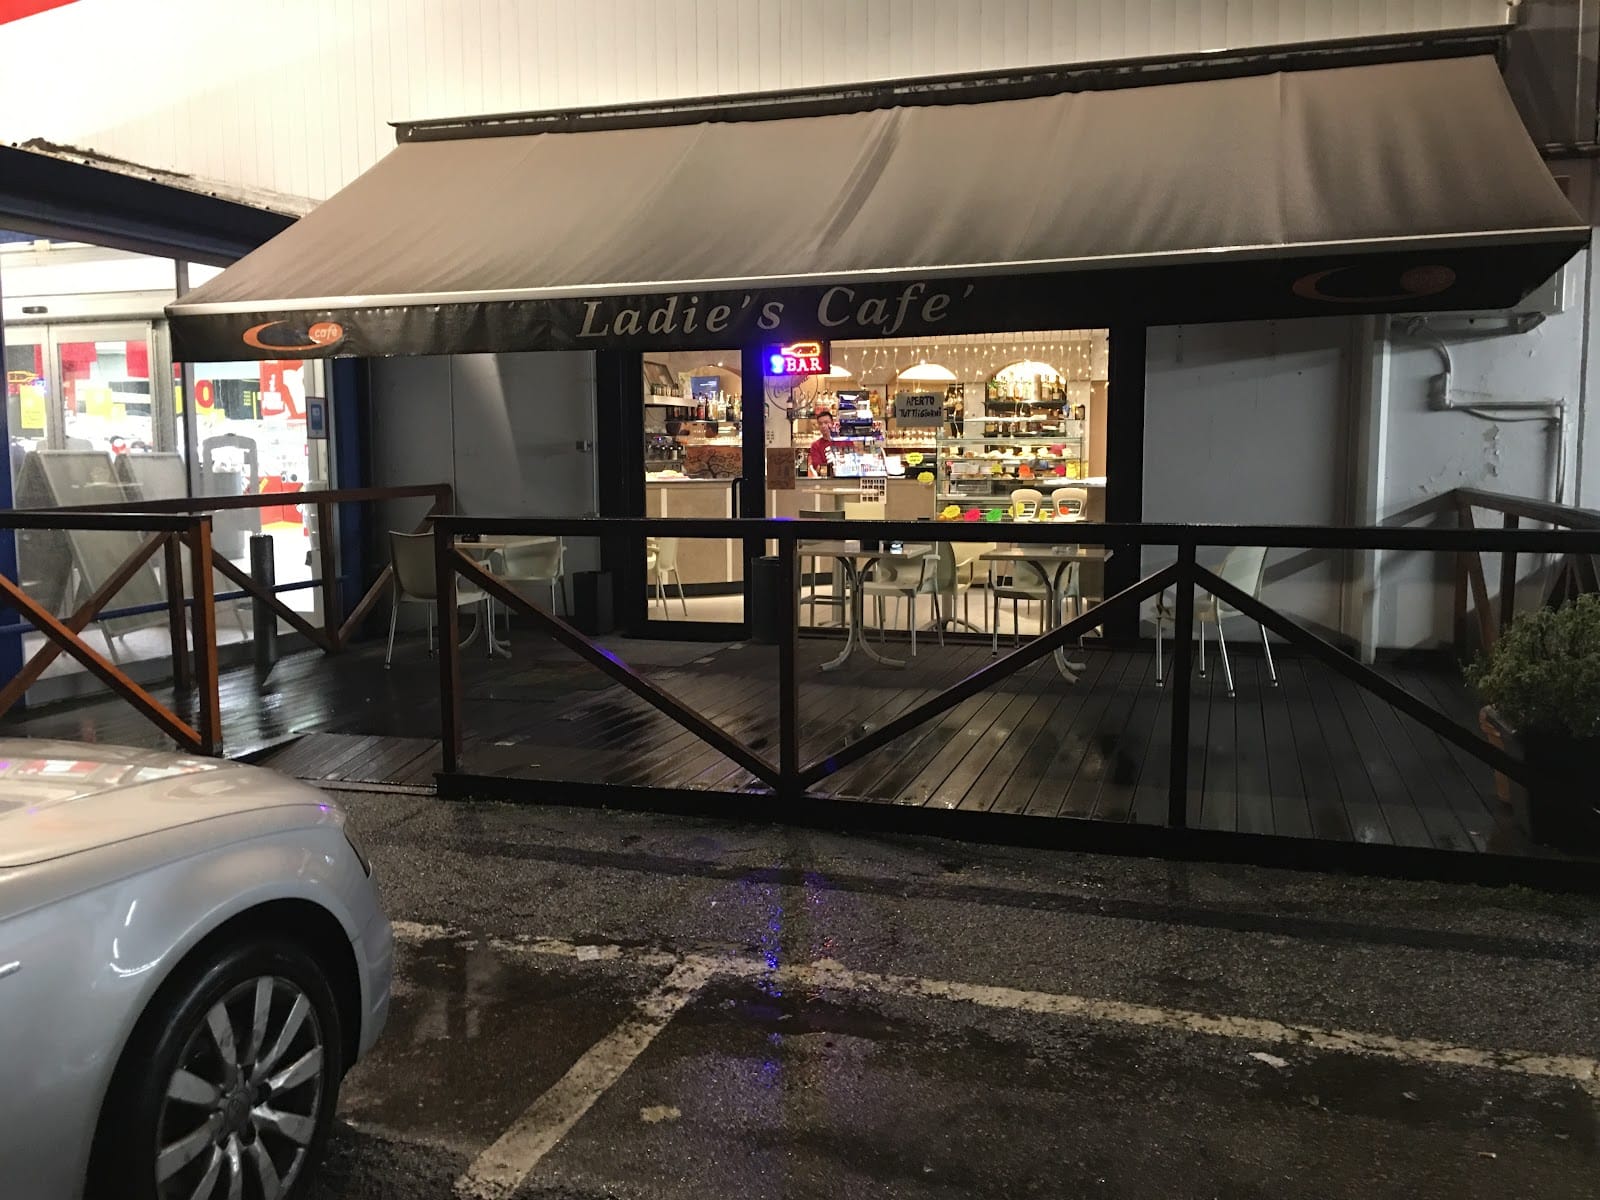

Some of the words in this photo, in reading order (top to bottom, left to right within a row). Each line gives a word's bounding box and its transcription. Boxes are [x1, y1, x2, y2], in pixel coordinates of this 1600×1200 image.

[576, 294, 785, 338] Ladie's
[785, 357, 823, 372] BAR
[906, 395, 935, 406] APERTO
